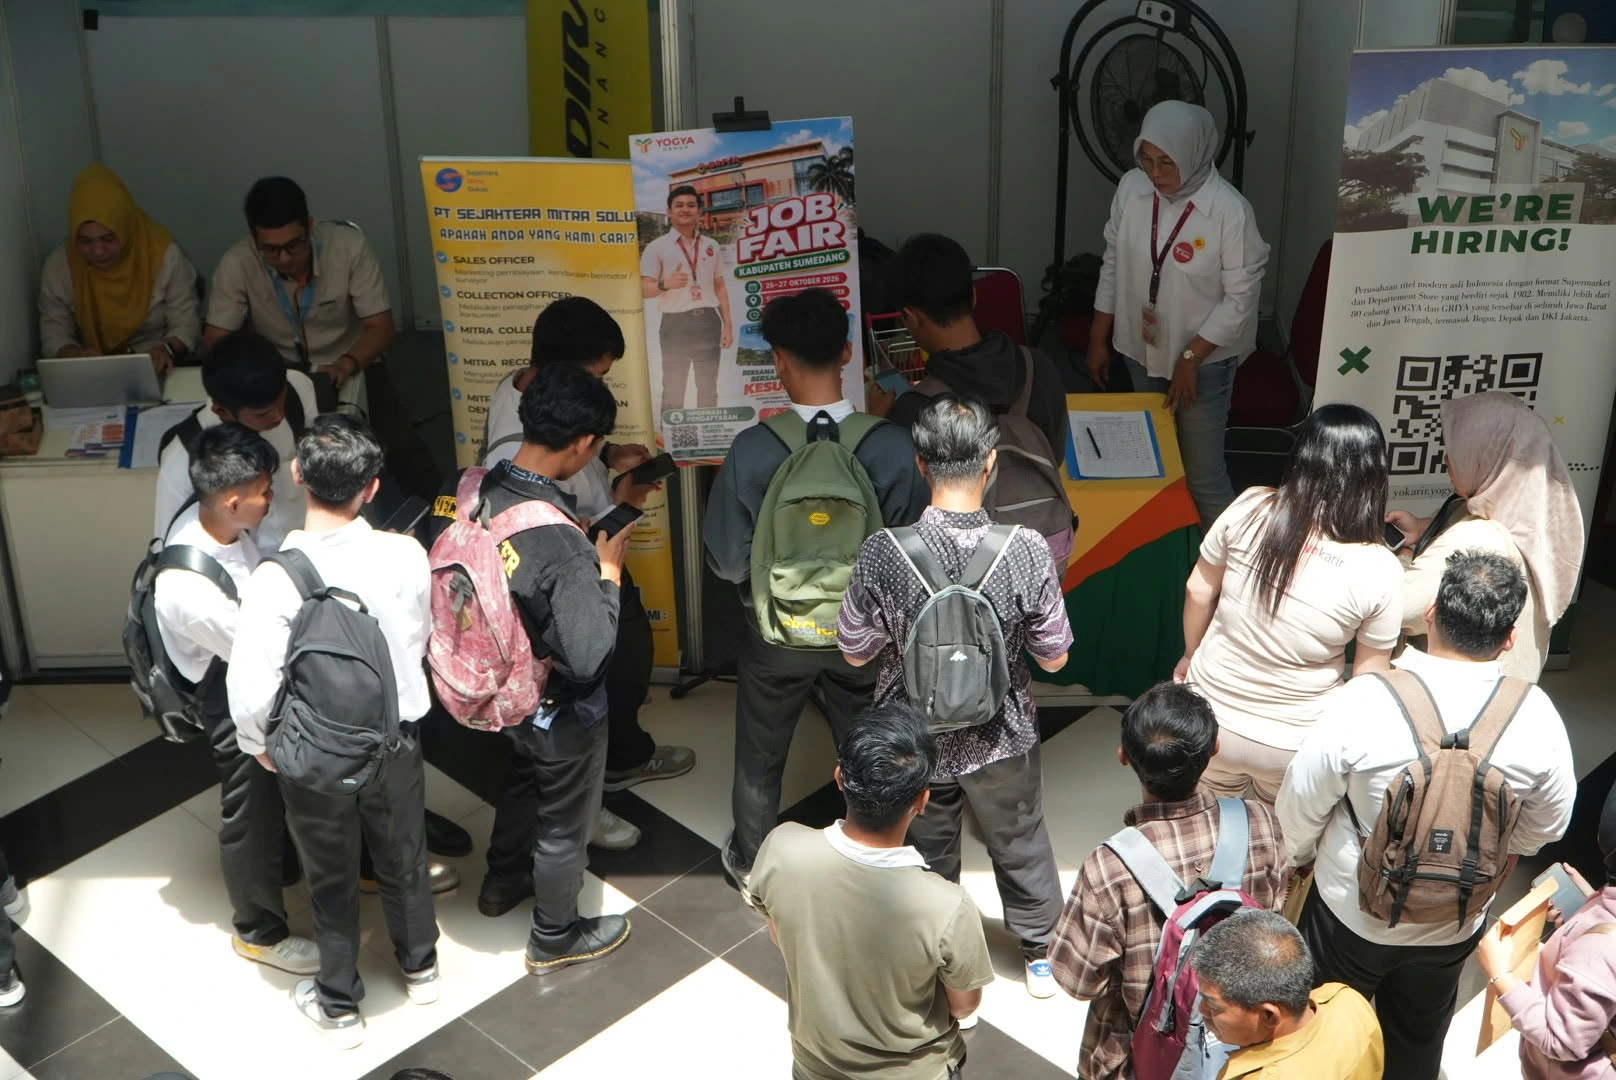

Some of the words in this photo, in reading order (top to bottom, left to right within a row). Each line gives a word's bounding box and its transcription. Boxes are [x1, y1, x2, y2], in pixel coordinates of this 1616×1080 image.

[655, 136, 695, 147] YOGYA
[434, 207, 450, 218] PT
[457, 208, 541, 219] SEJAHTERA
[547, 209, 590, 222] MITRA
[747, 194, 834, 235] JOB
[1417, 193, 1575, 224] WE'RE
[440, 228, 486, 240] APAKAH
[491, 230, 524, 240] ANDA
[529, 230, 560, 240] YANG
[565, 231, 595, 243] KAMI
[600, 232, 635, 243] CARI?
[738, 221, 844, 262] FAIR
[1411, 228, 1572, 254] HIRING!
[453, 256, 487, 264] SALES
[489, 256, 535, 264] OFFICER
[739, 263, 792, 276] KABUPATEN
[792, 252, 846, 269] SUMEDANG
[789, 276, 820, 287] OKTOBER
[1355, 284, 1398, 294] Perusahaan
[1418, 280, 1447, 288] modern
[1450, 280, 1464, 288] asli
[1466, 279, 1504, 287] Indonesia
[1505, 279, 1533, 288] dengan
[1535, 278, 1559, 286] format
[1561, 277, 1611, 287] Supermarket
[457, 290, 524, 299] COLLECTION
[1418, 292, 1439, 300] Store
[1441, 294, 1459, 302] yang
[1536, 289, 1571, 297] Memiliki
[1573, 289, 1593, 298] lebih
[1363, 307, 1390, 317] cabang
[1393, 304, 1422, 313] YOGYA
[1441, 303, 1469, 312] GRIYA
[1471, 304, 1489, 312] yang
[1492, 302, 1523, 310] tersebar
[1525, 302, 1532, 310] di
[1565, 301, 1584, 309] Jawa
[1586, 302, 1607, 310] Barat
[1367, 319, 1381, 328] dan
[1382, 318, 1401, 327] Jawa
[1435, 315, 1469, 324] termasuk
[1499, 314, 1522, 324] Depok
[460, 325, 494, 334] MITRA
[463, 358, 496, 366] MITRA
[742, 368, 775, 376] BERSAMA
